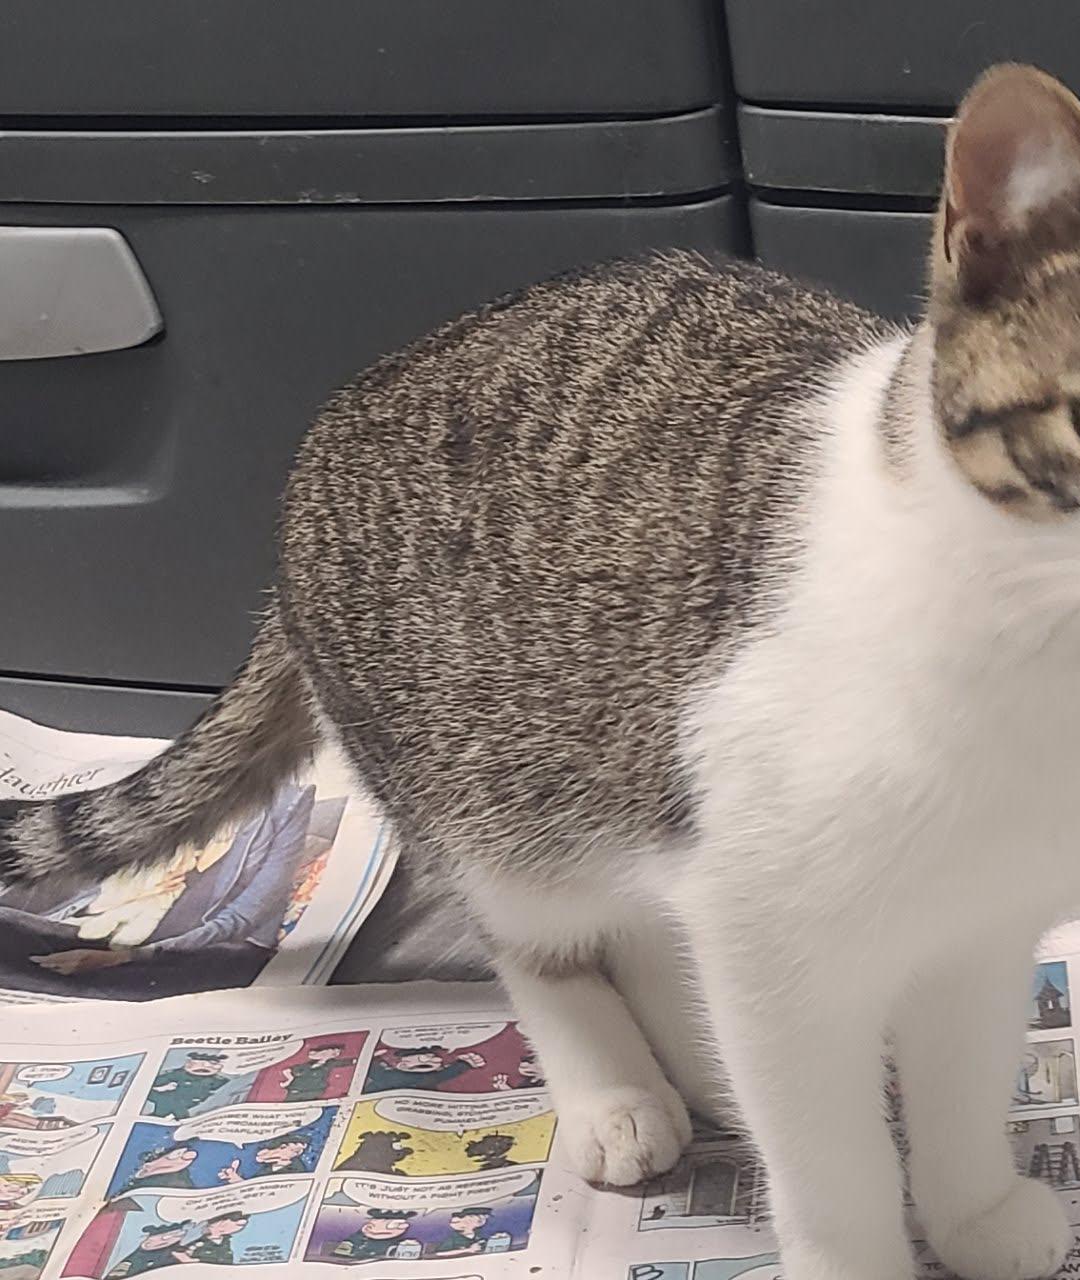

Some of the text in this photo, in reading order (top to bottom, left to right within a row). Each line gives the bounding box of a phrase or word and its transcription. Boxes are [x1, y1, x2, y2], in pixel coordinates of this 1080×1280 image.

[170, 1033, 293, 1045] Beetle Bailey
[413, 1185, 435, 1193] NOT
[368, 1192, 416, 1200] WITHOUT
